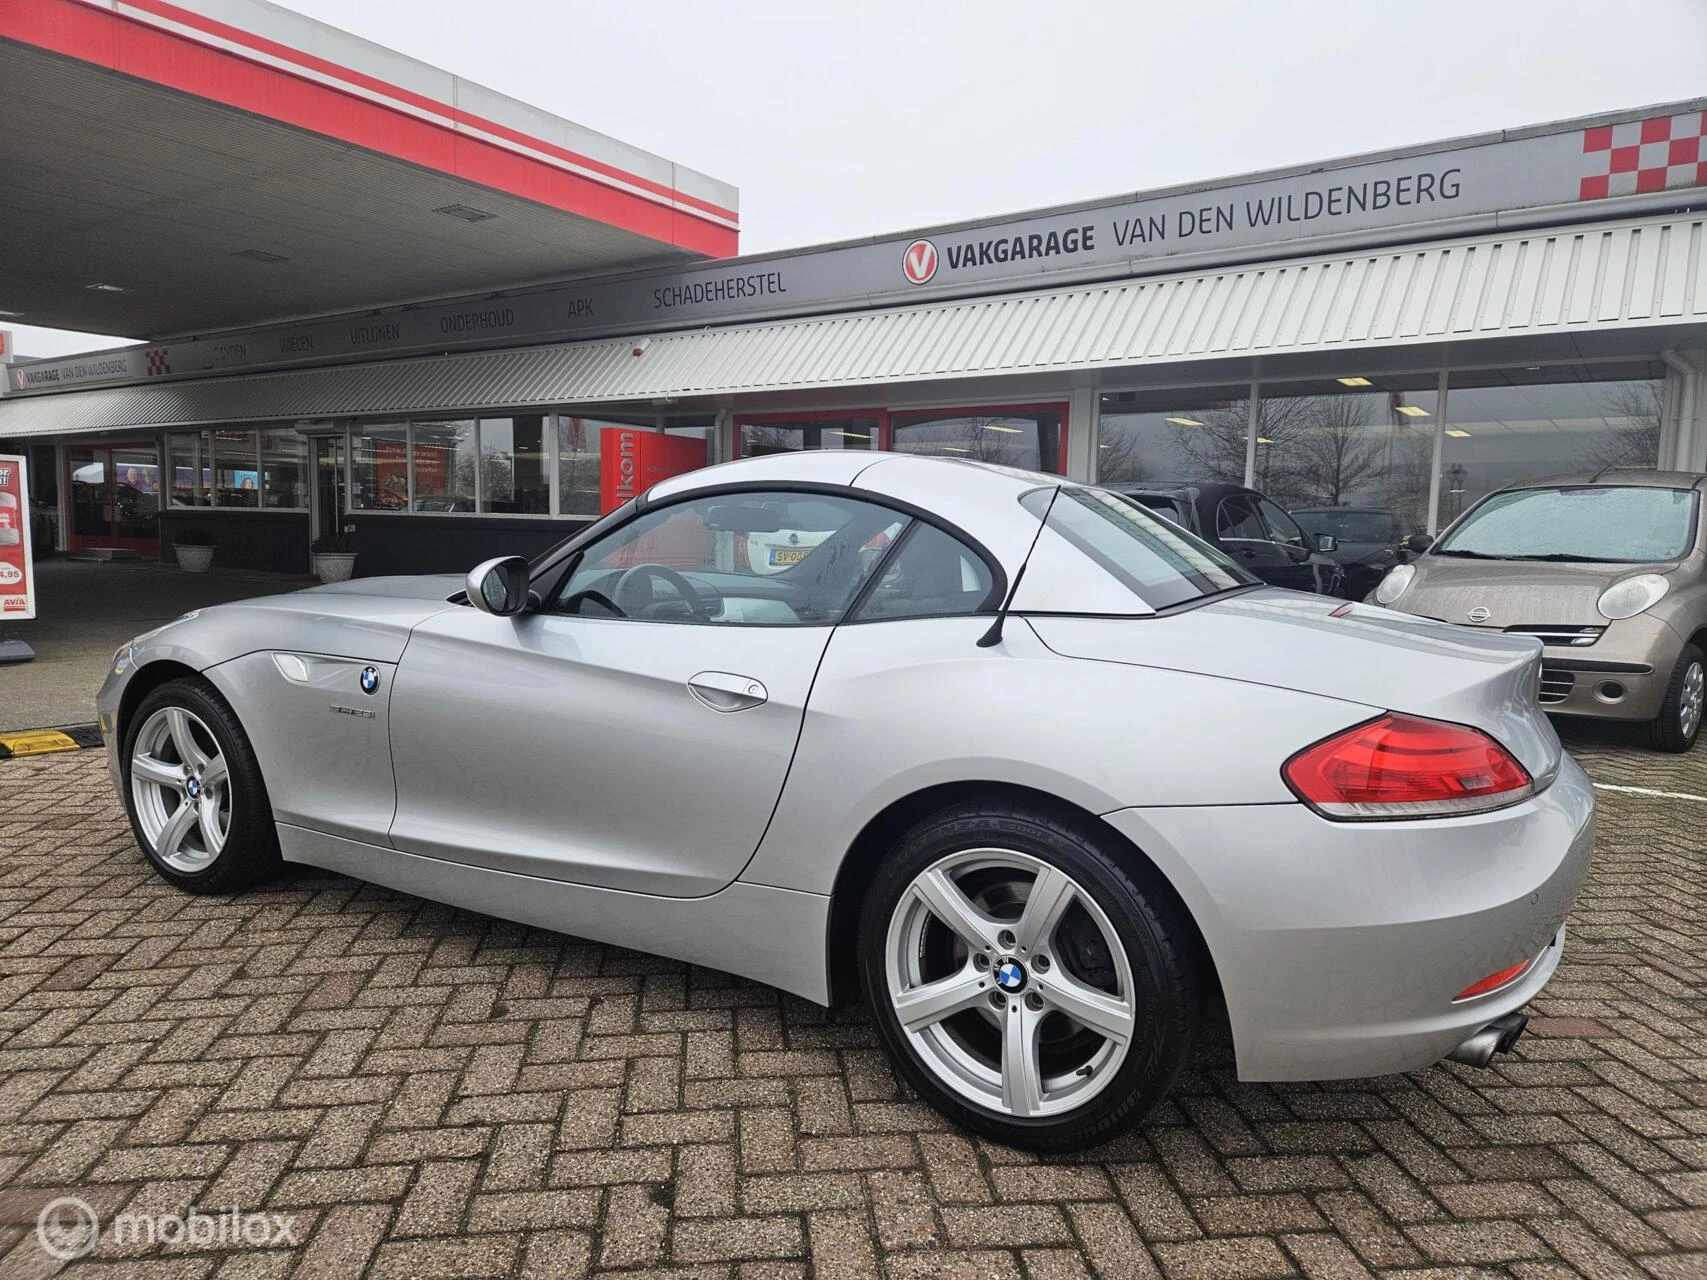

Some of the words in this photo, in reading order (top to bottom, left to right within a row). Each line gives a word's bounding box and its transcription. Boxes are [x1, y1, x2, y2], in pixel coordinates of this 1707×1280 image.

[947, 226, 1095, 269] VAKGARAGE
[1113, 214, 1165, 247] VAN
[1178, 203, 1234, 239] DEN
[1245, 168, 1462, 229] WILDENBERG
[653, 272, 786, 309] SCHADEHERSTEL
[568, 298, 594, 319] APK
[440, 309, 514, 333] ONDERHOUD
[351, 324, 400, 344] UITLIJNEN
[26, 369, 59, 383] VAKGARAGE
[61, 366, 75, 379] VAN
[75, 364, 88, 378] DEN
[88, 360, 127, 377] WILDENBERG
